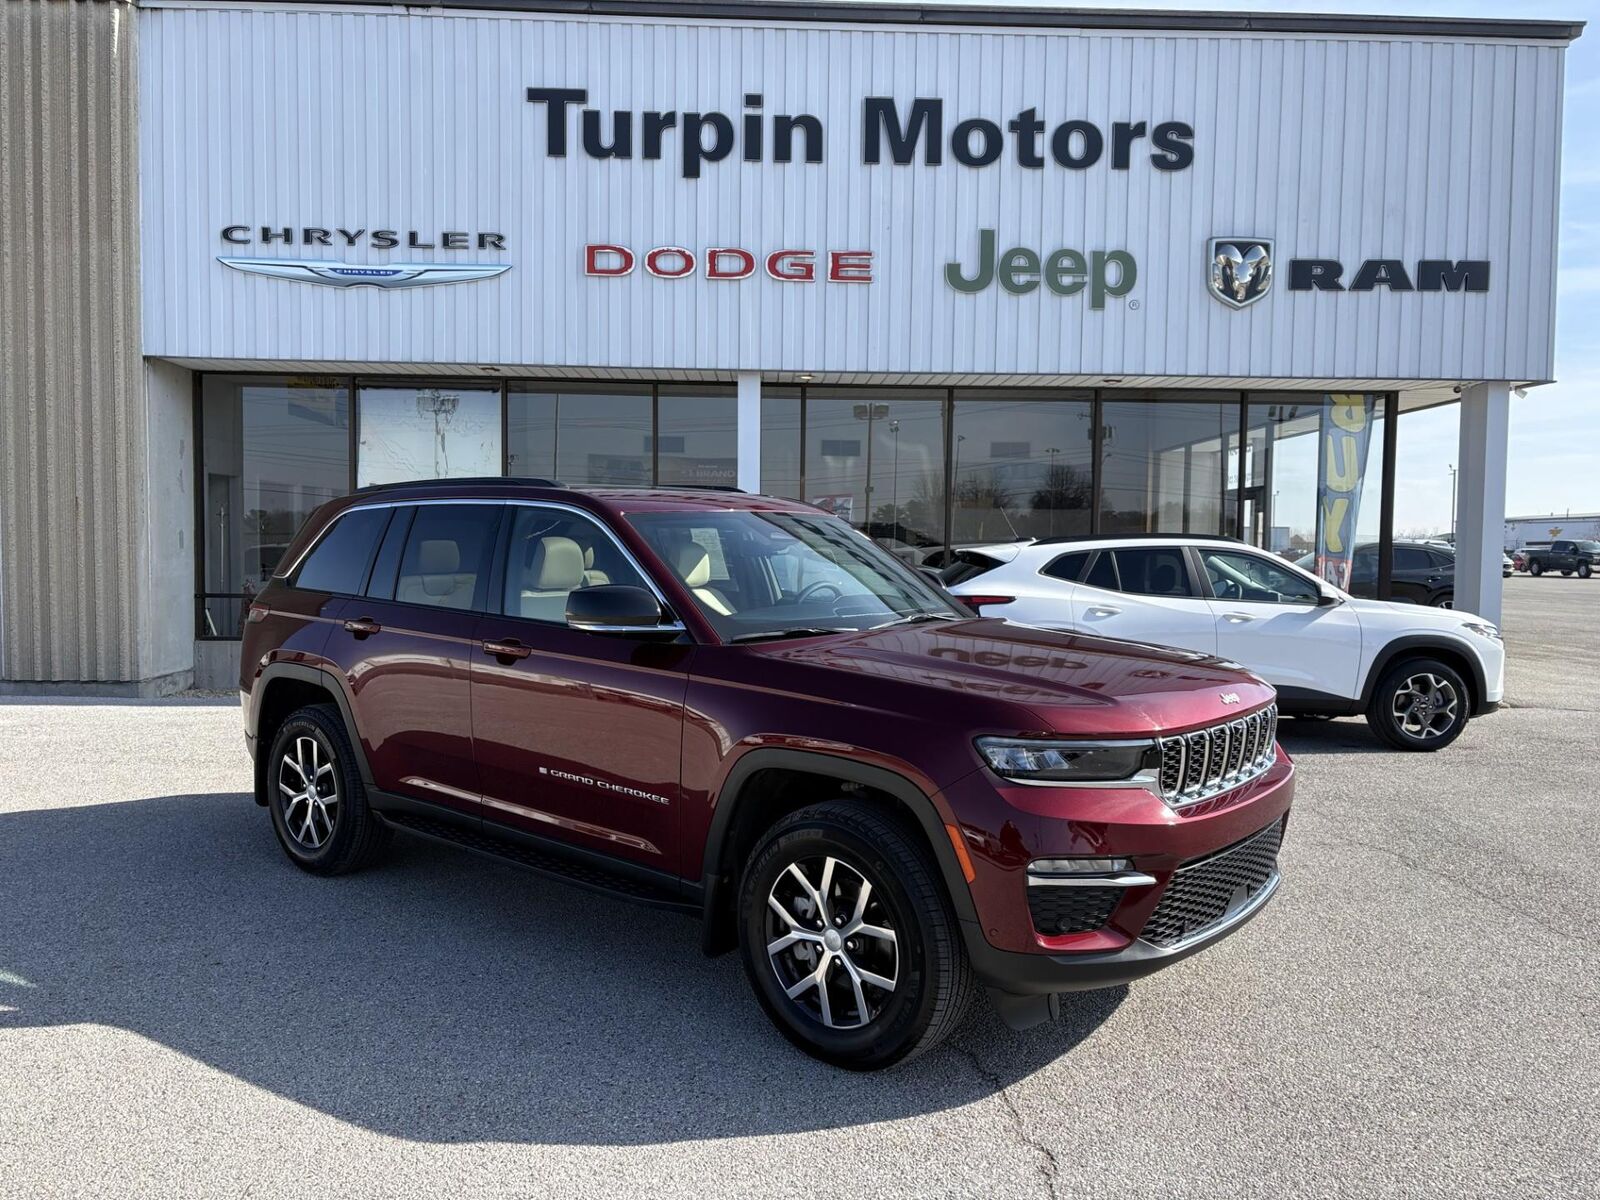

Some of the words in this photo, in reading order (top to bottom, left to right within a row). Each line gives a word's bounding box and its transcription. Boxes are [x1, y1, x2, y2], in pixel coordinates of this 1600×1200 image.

[527, 87, 823, 178] Turpin
[863, 97, 1195, 171] Motors
[221, 226, 507, 250] CHRYSLER
[584, 244, 875, 283] DODGE
[944, 228, 1138, 310] Jeep
[1288, 259, 1490, 292] RAM
[550, 769, 594, 785] GRAND
[597, 781, 670, 805] CHEROKEE
